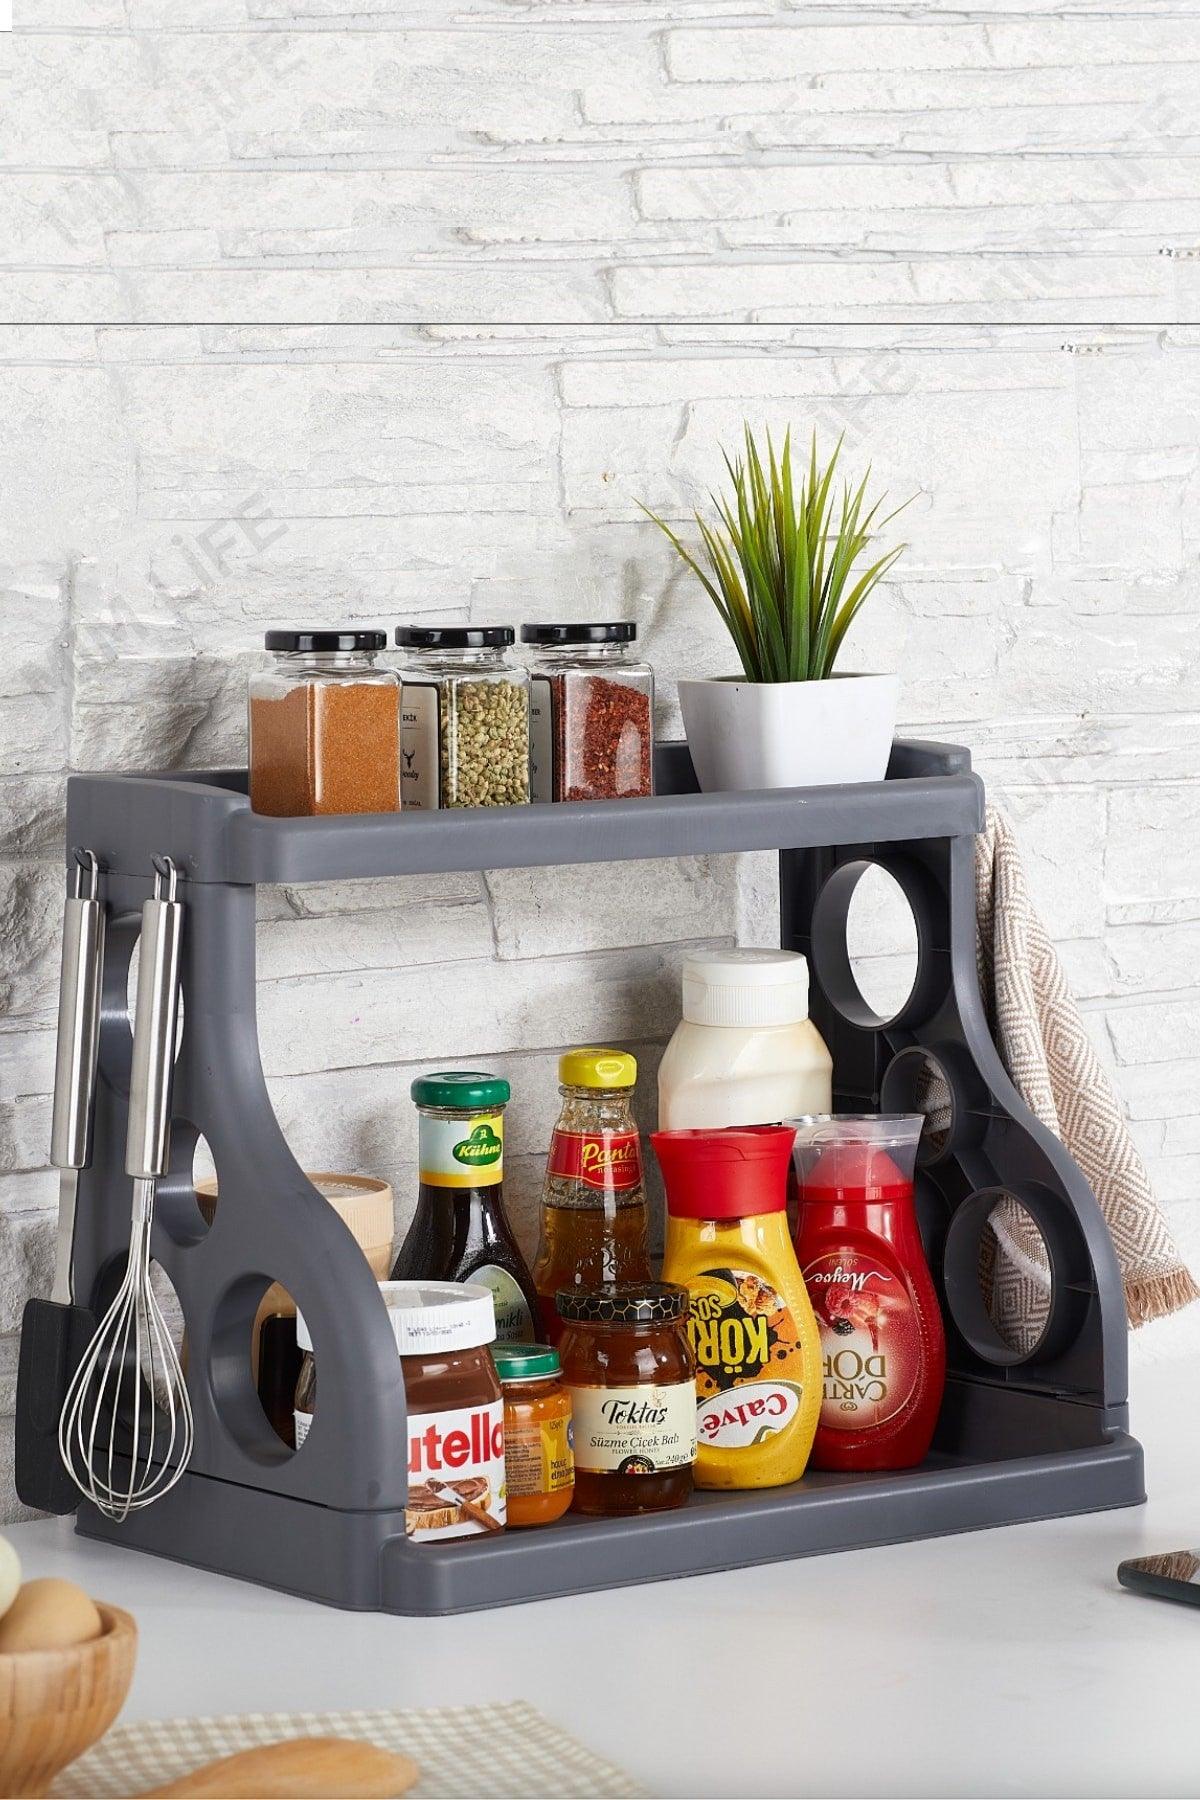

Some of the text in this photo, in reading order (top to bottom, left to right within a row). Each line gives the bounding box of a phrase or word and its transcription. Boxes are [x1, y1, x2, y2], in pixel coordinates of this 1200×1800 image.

[458, 1143, 501, 1157] Kühne
[814, 1266, 868, 1291] Meyve
[689, 1294, 722, 1322] SOS
[601, 1399, 668, 1426] Toktaş
[702, 1393, 788, 1439] Calvé
[589, 1436, 628, 1449] Süzme
